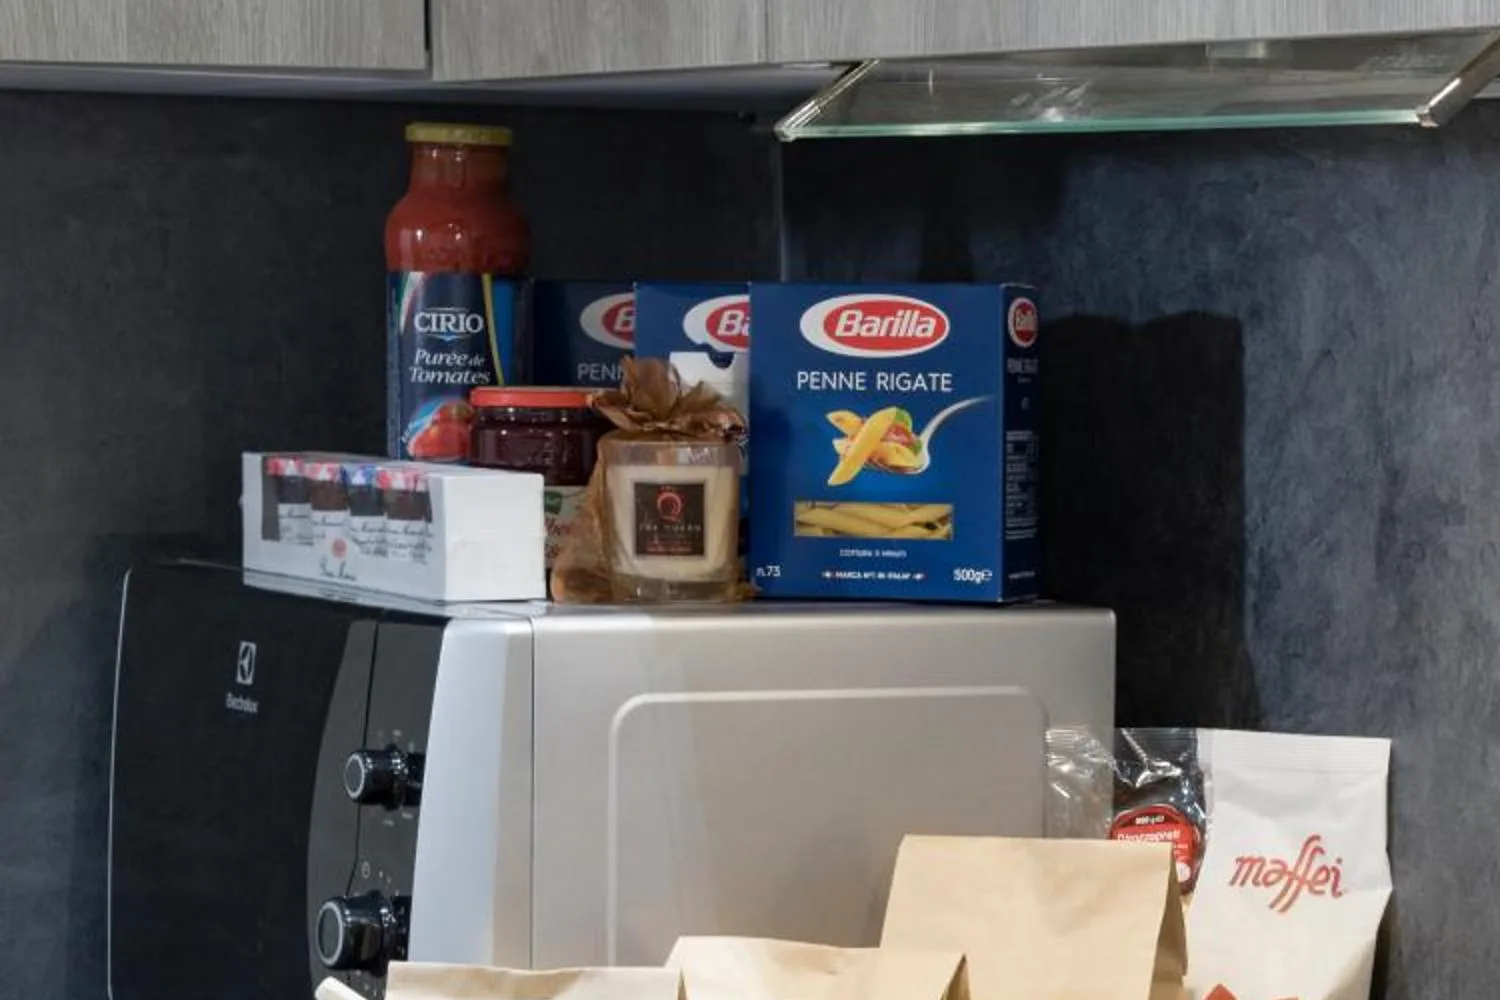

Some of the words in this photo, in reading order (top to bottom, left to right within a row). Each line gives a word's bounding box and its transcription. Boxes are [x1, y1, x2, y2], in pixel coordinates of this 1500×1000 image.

[414, 311, 484, 334] CIRIO
[835, 309, 937, 338] Barilla
[468, 352, 485, 367] de
[409, 365, 492, 384] Tomates
[796, 370, 867, 392] PENNE
[876, 371, 954, 393] RIGATE
[1229, 834, 1343, 913] maffei
